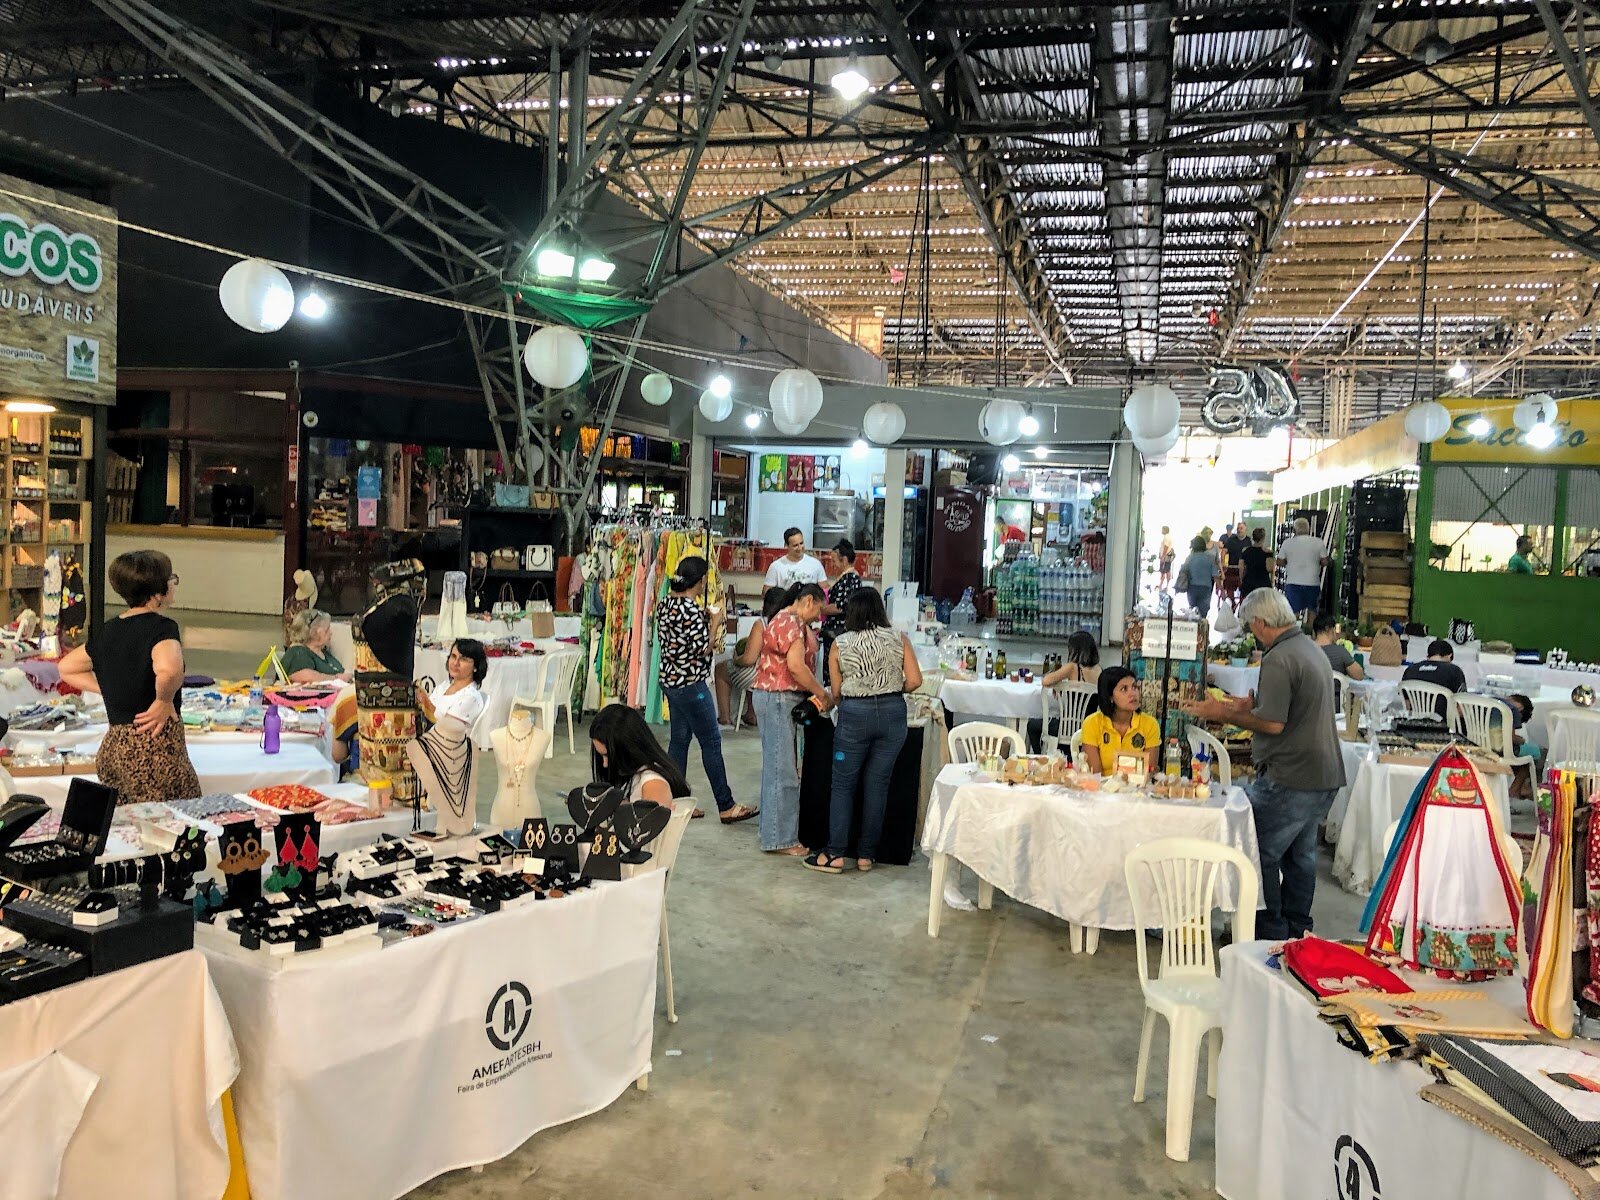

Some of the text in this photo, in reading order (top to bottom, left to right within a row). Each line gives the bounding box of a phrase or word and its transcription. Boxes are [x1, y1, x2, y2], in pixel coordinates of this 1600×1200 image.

[457, 1084, 475, 1094] Feira
[475, 1081, 484, 1090] de
[526, 1051, 553, 1065] Artesanal
